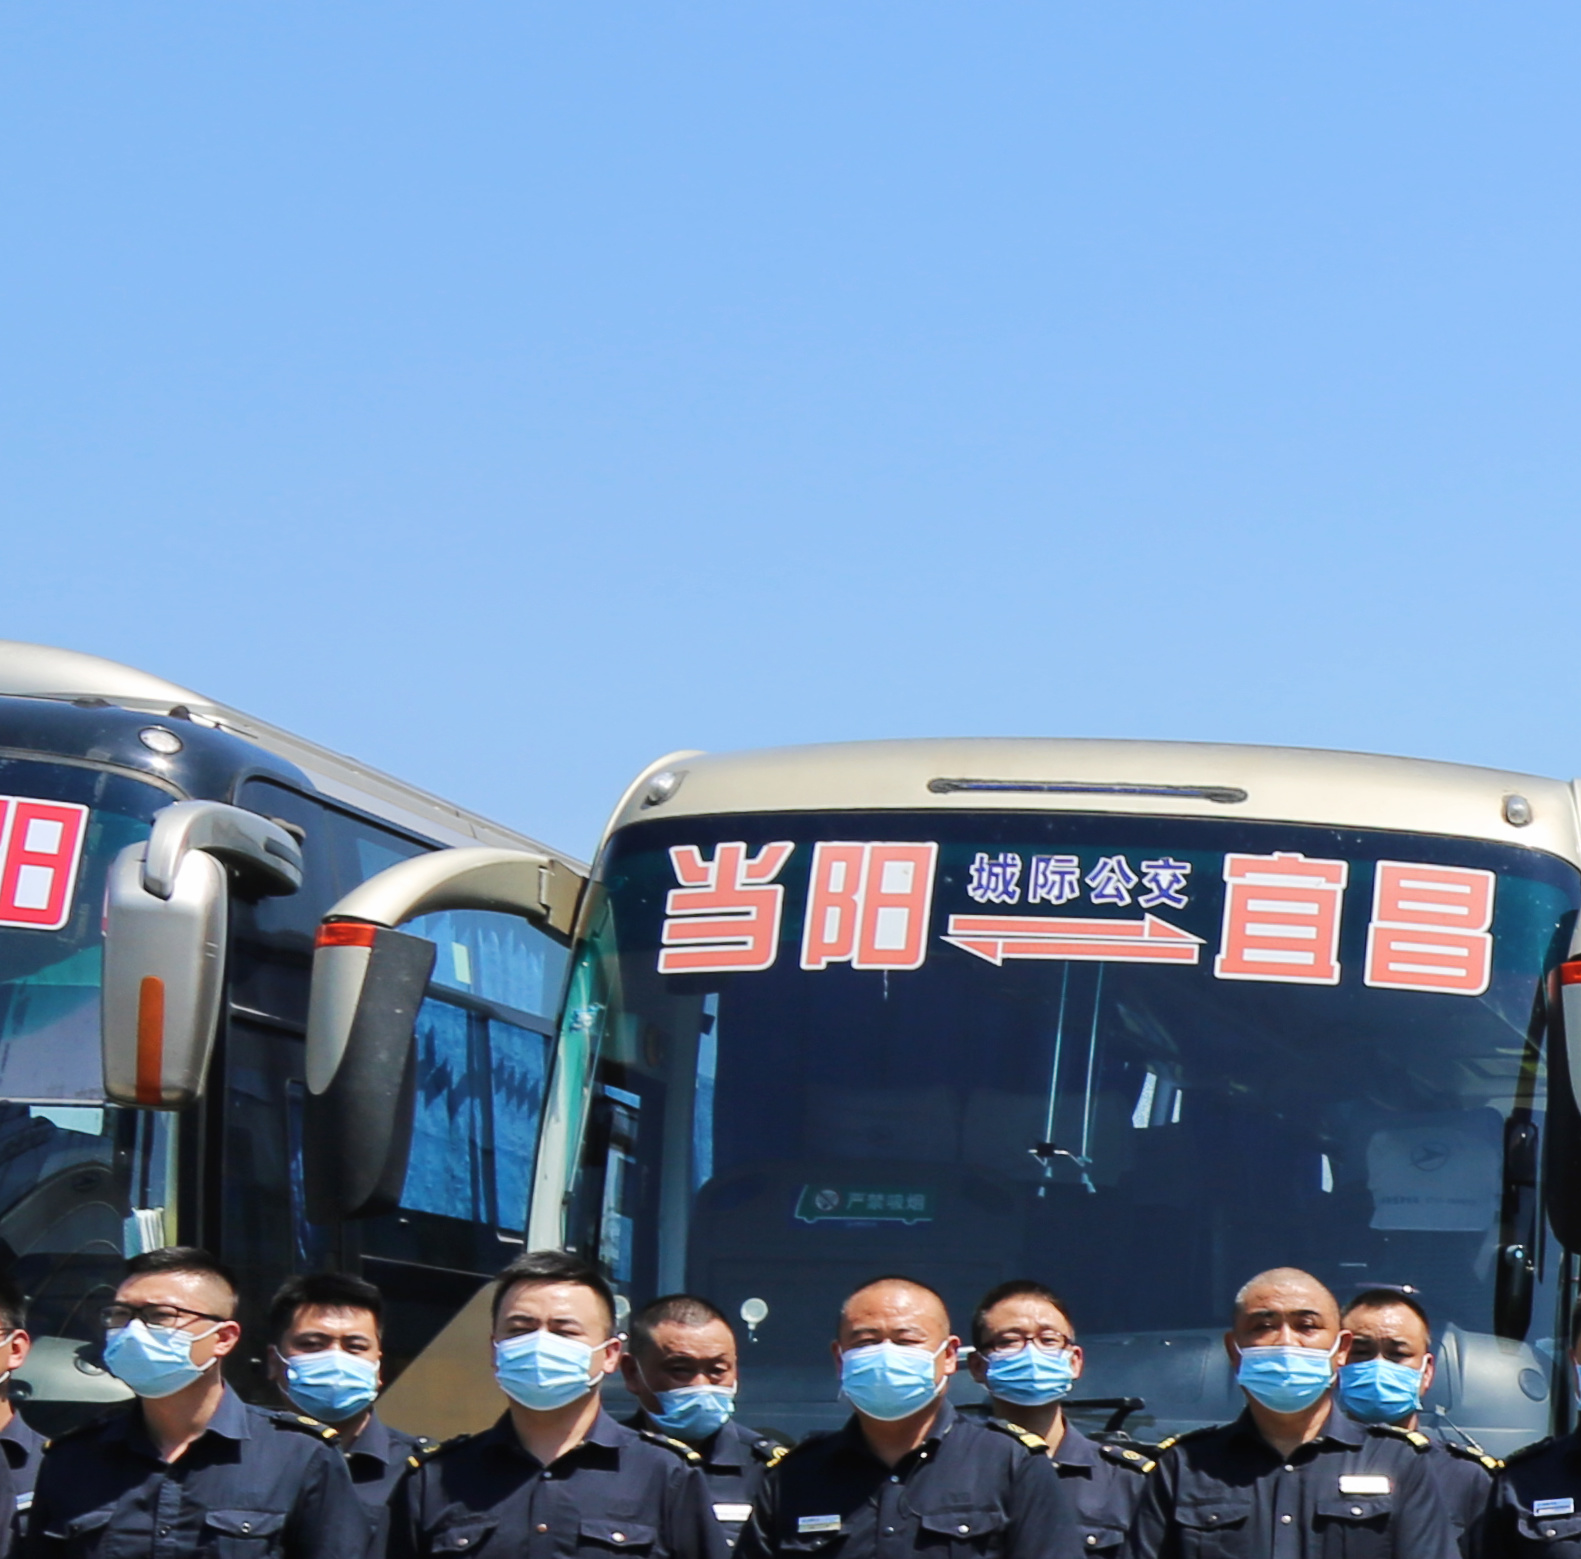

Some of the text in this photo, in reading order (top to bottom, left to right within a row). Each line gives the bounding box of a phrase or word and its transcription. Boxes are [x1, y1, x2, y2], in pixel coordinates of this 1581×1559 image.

[657, 841, 1497, 996] 当阳 城际公交 宜昌
